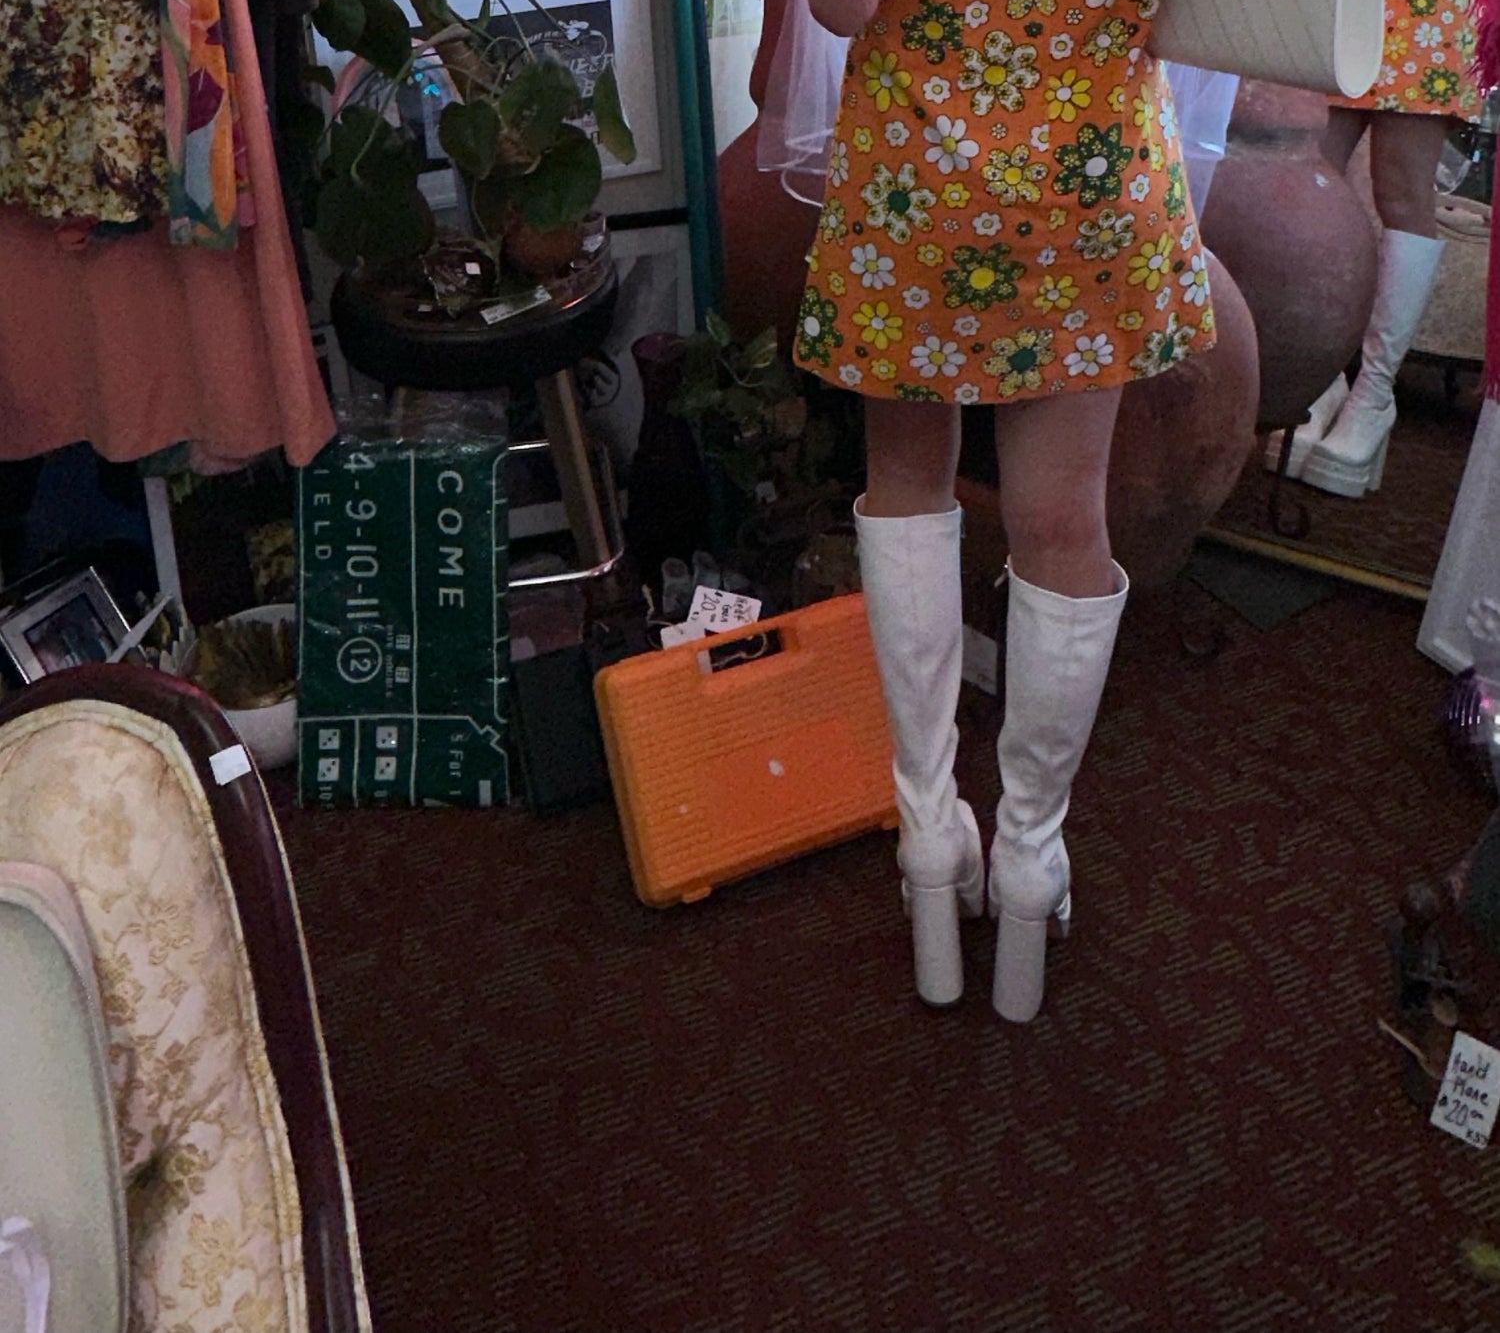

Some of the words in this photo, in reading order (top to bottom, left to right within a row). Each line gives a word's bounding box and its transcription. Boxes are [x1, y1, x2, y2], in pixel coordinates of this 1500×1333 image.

[313, 469, 331, 559] IELD
[437, 470, 464, 608] COME
[449, 750, 464, 778] For
